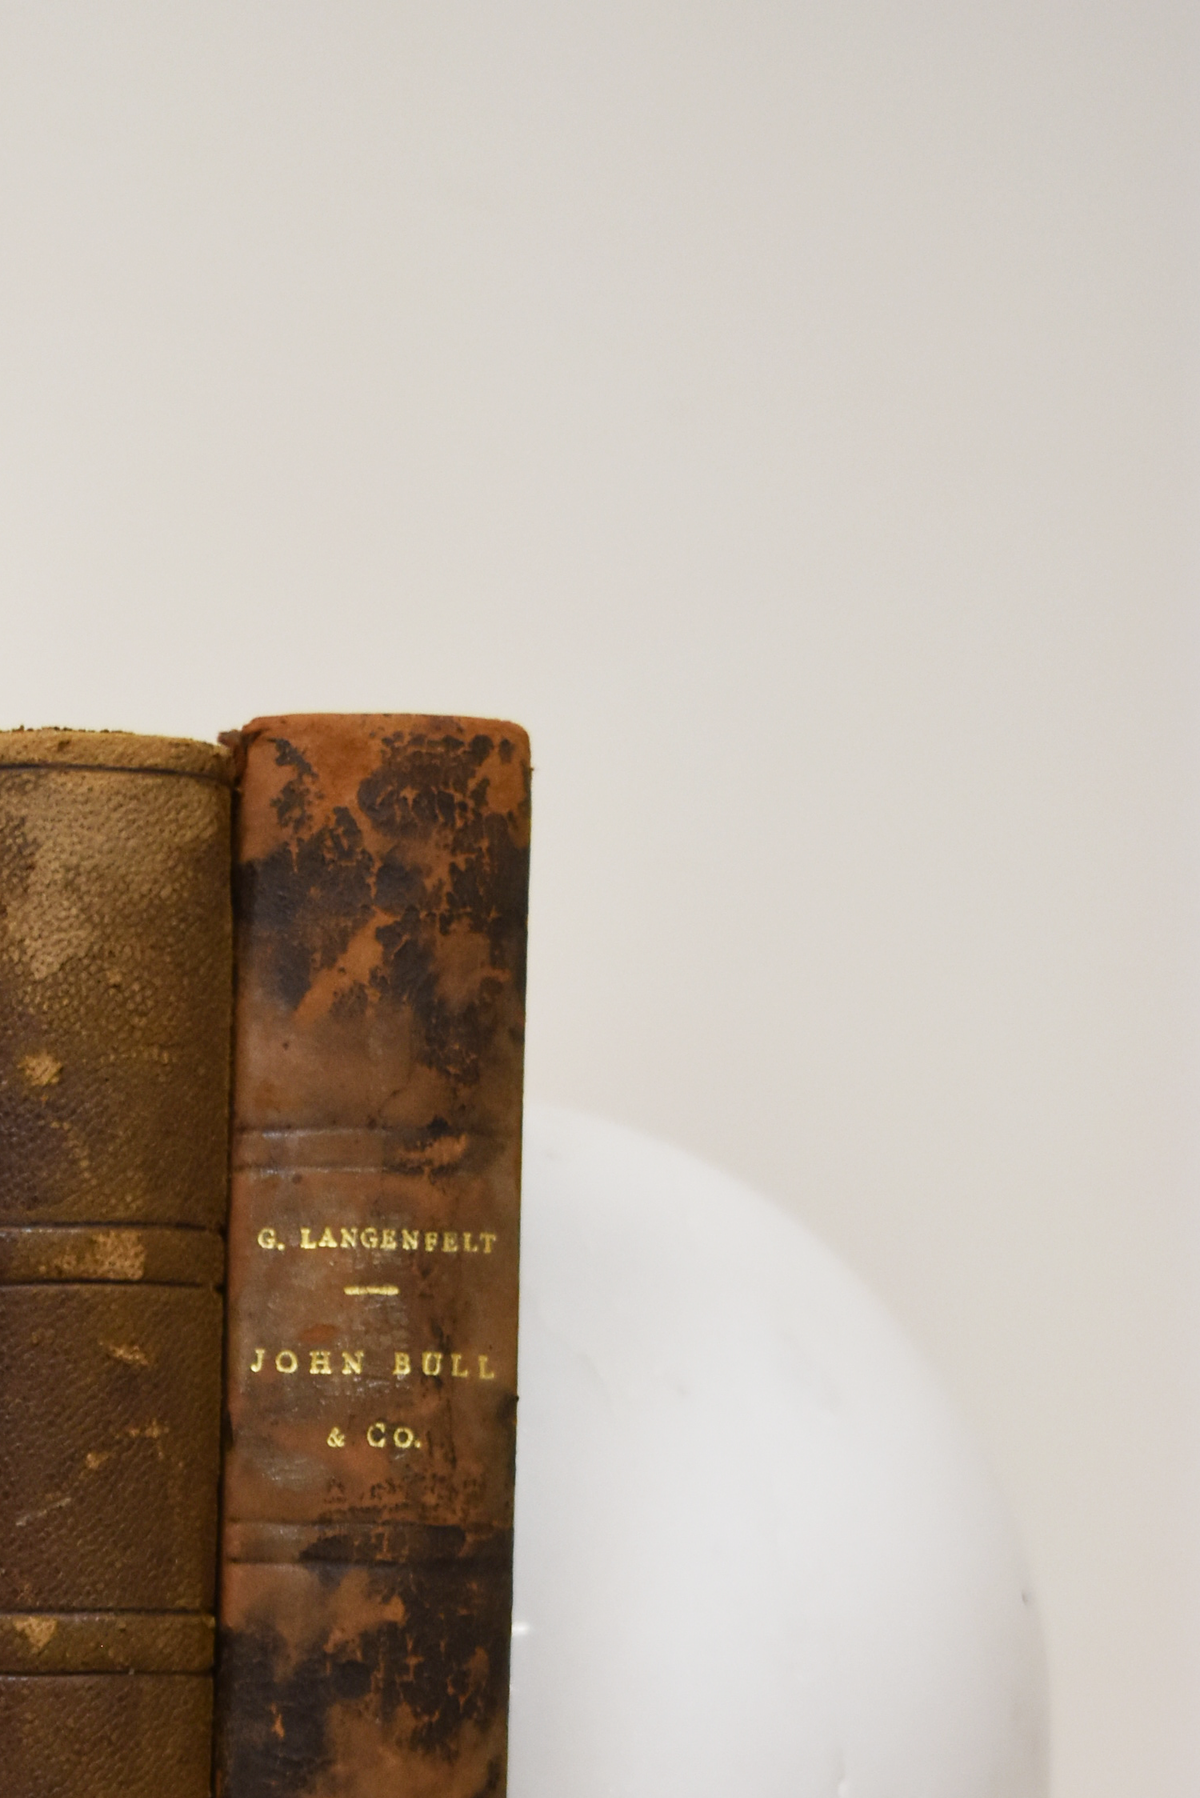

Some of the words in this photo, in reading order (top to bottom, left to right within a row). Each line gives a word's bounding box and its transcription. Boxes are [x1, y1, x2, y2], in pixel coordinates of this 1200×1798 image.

[257, 1227, 286, 1251] G.
[300, 1227, 497, 1254] LANGENFELT
[250, 1349, 365, 1376] JOHN
[392, 1351, 496, 1380] BULL
[326, 1427, 346, 1448] &
